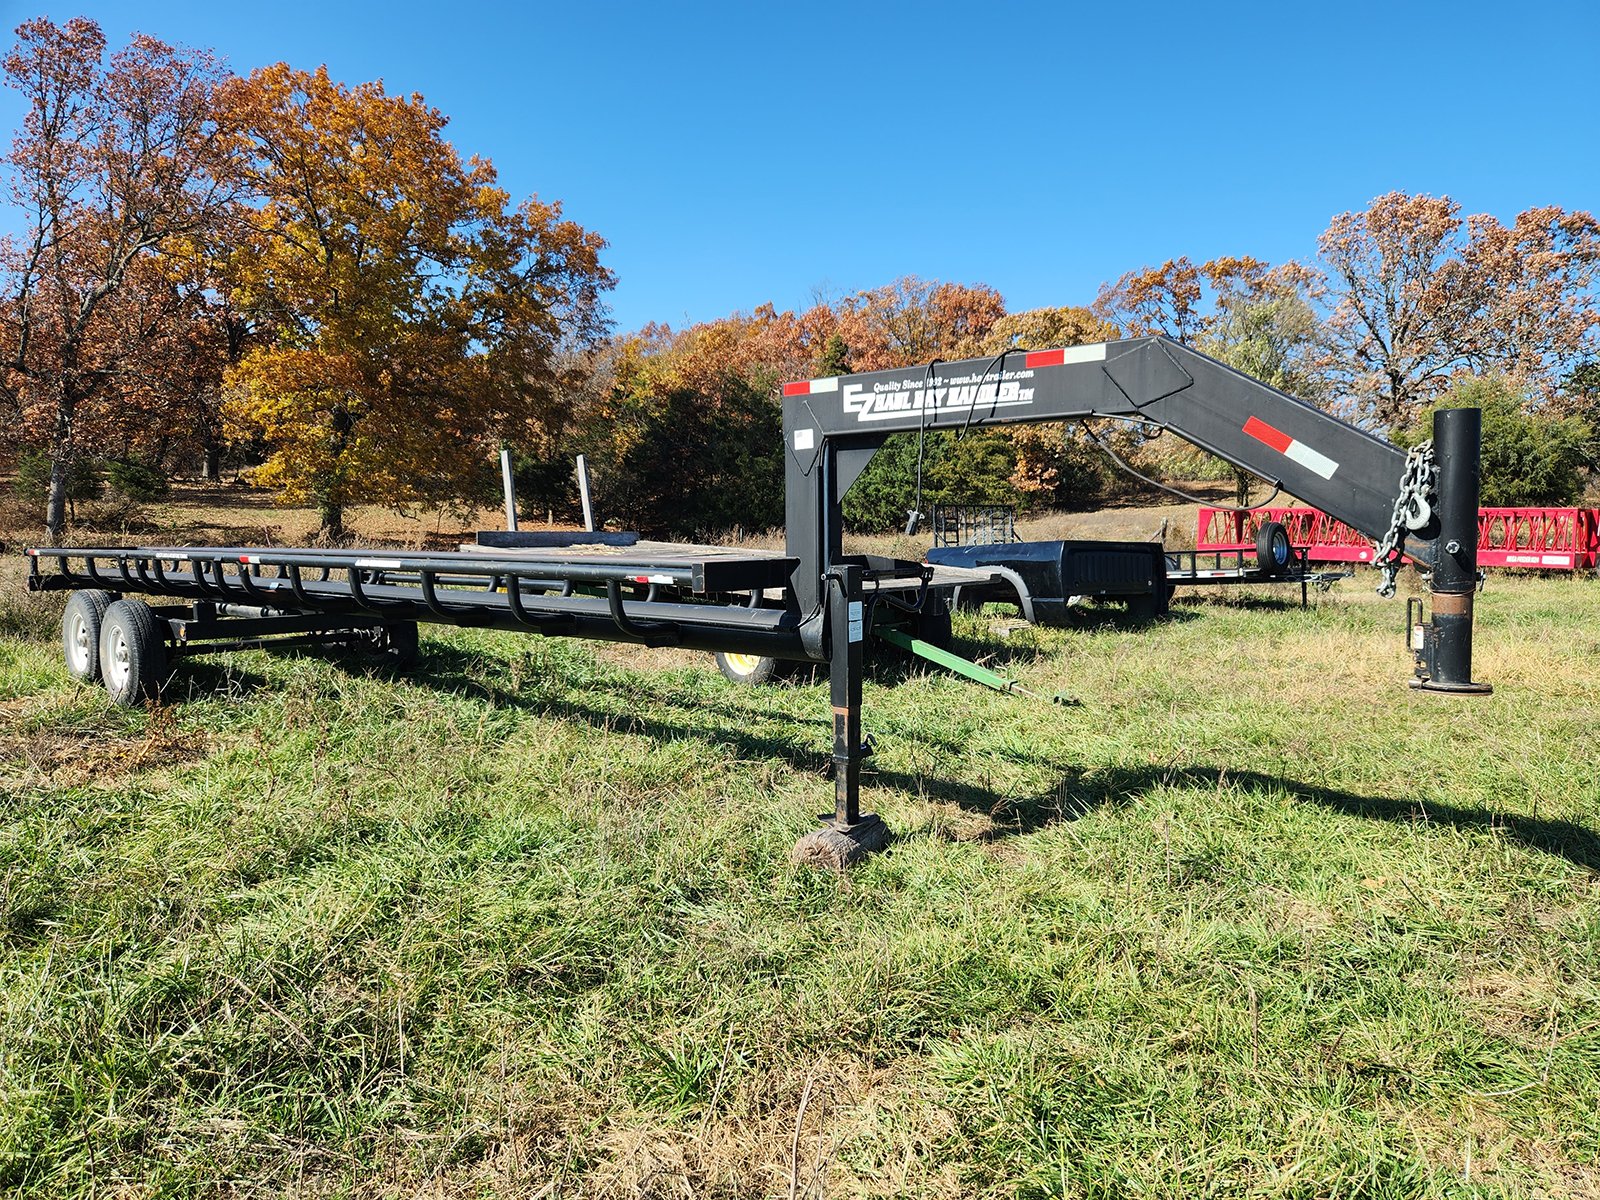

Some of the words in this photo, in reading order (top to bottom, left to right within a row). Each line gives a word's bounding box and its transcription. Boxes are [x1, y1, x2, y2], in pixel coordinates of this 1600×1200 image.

[873, 381, 902, 393] Quality
[902, 379, 923, 390] Since
[843, 383, 876, 422] EZ
